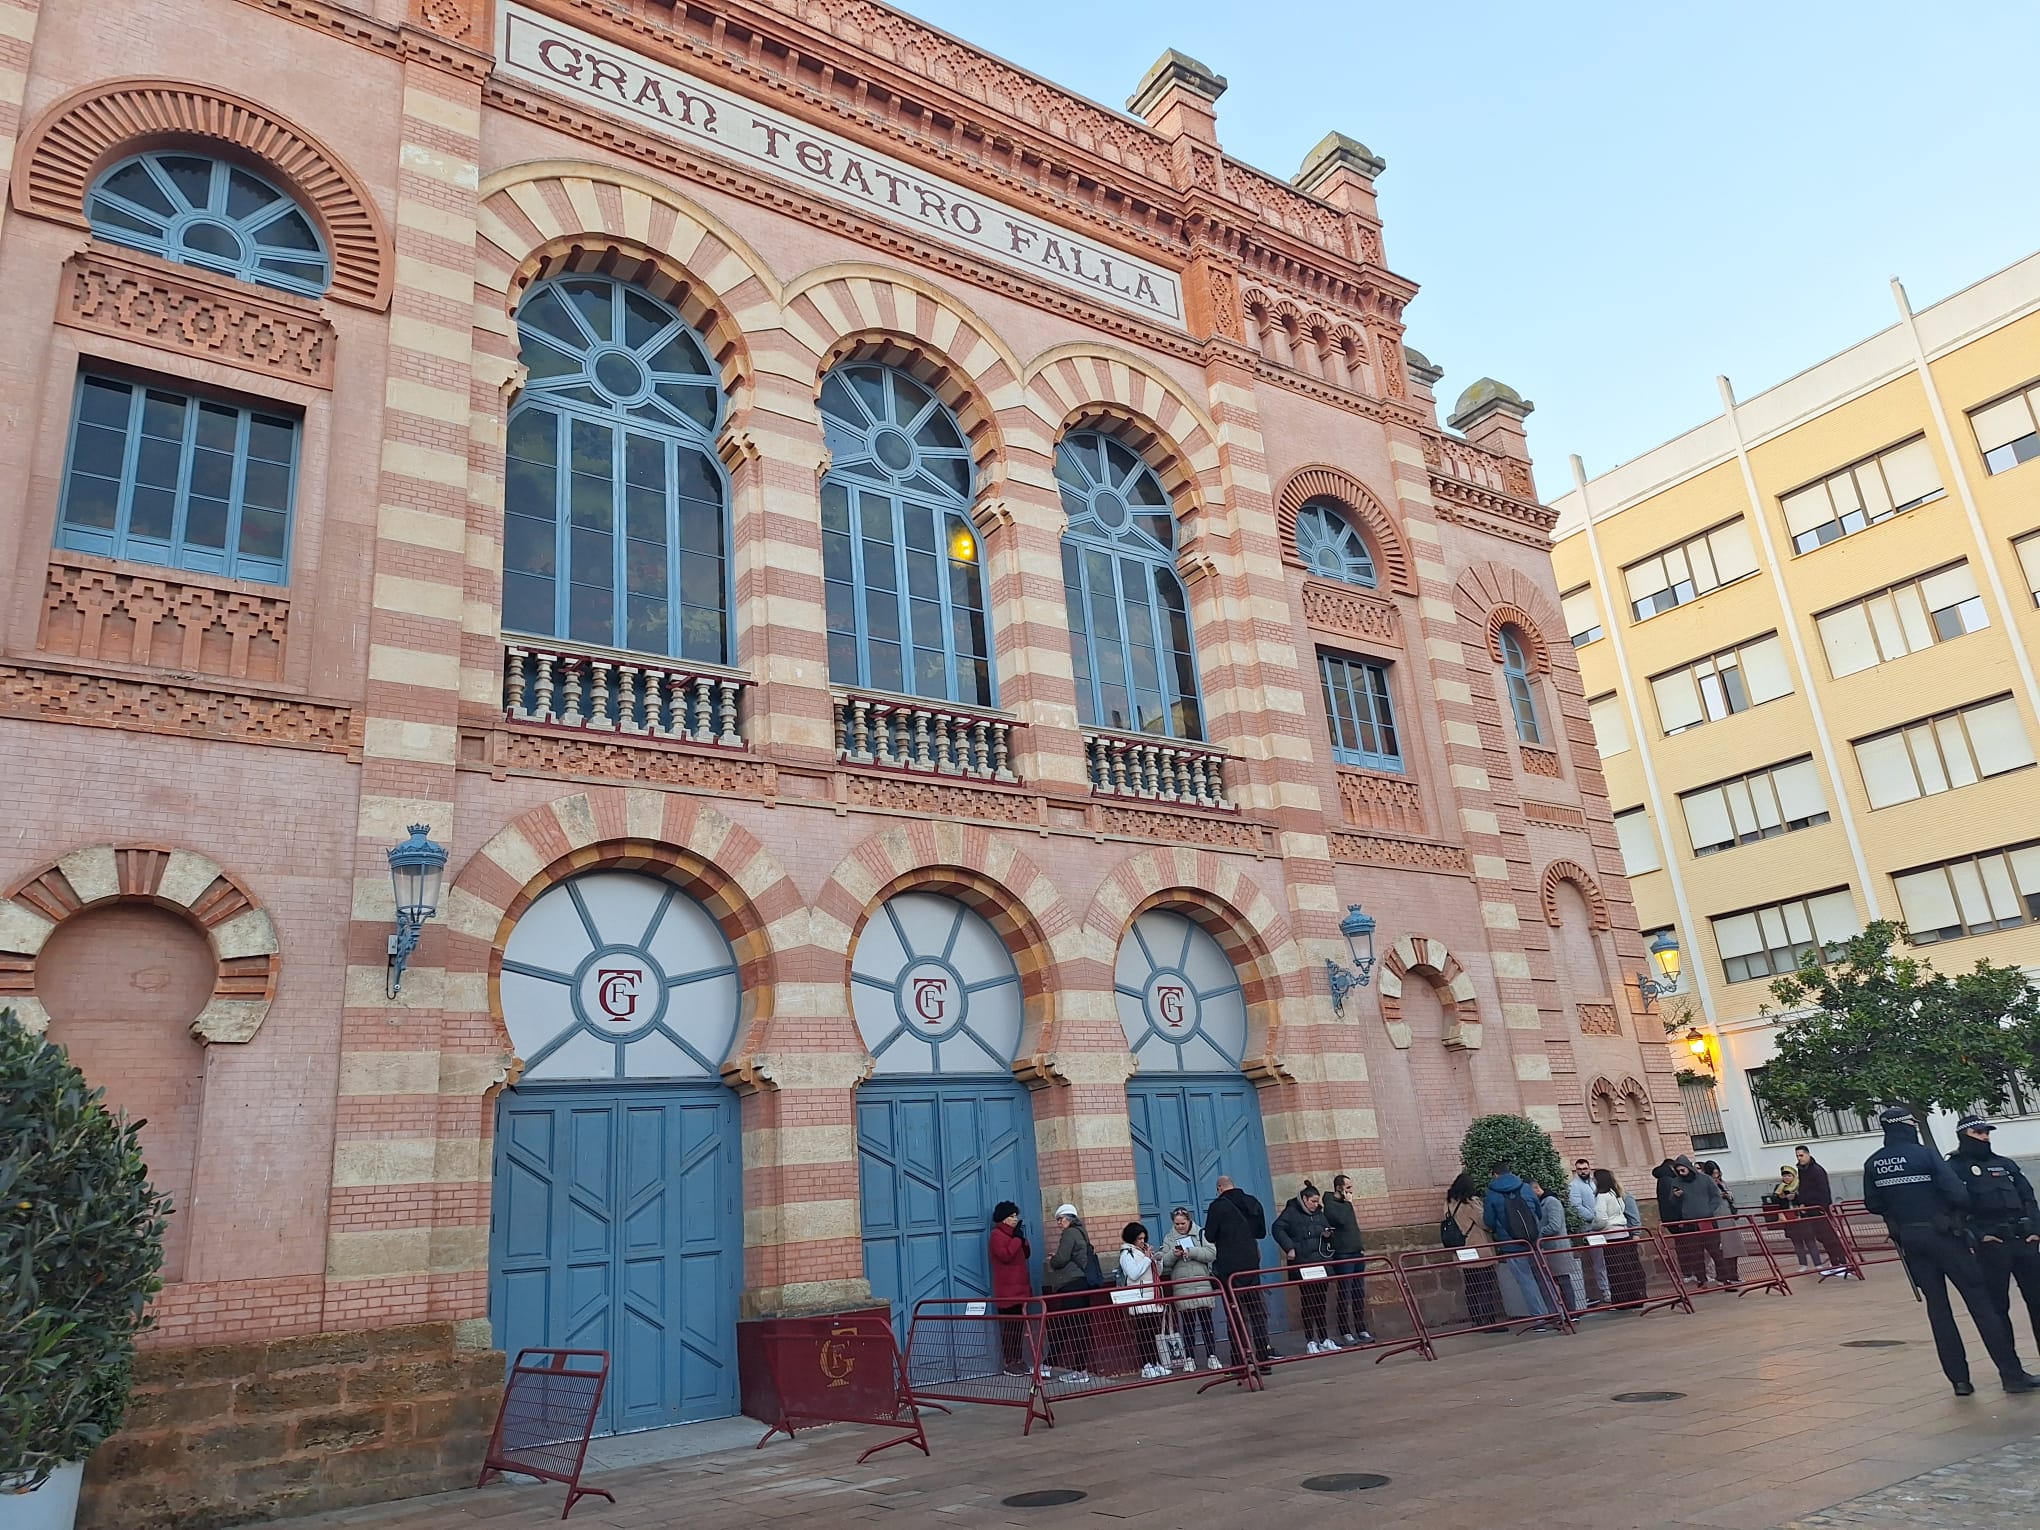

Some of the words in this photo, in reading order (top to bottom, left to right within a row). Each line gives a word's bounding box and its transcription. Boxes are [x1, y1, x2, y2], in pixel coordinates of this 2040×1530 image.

[538, 39, 717, 134] GRAN
[751, 119, 982, 235] TEATRO
[1006, 221, 1160, 306] FALLA
[1873, 1156, 1907, 1168] POLICIA
[1876, 1164, 1905, 1174] LOCAL
